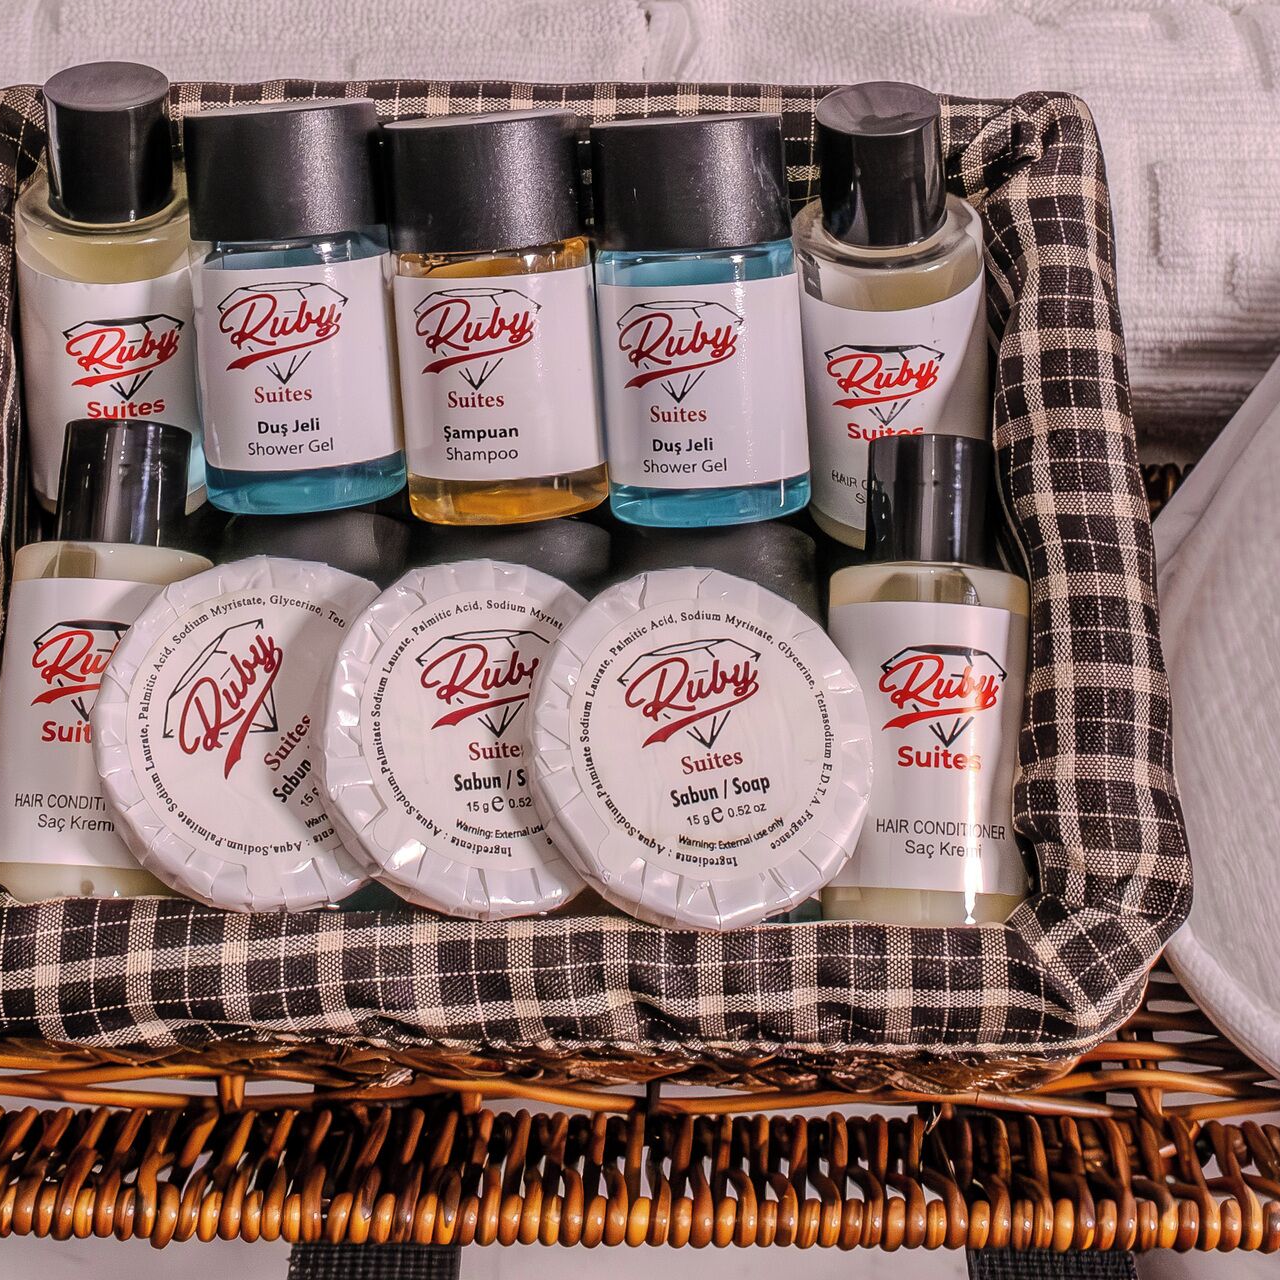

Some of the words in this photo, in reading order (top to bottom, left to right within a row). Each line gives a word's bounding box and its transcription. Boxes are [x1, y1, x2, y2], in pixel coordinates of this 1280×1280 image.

[219, 293, 342, 372] Ruby
[416, 298, 537, 374] Ruby
[65, 327, 183, 388] Ruby
[619, 312, 740, 389] Ruby
[826, 353, 941, 409] Ruby
[254, 385, 313, 404] Suites
[447, 391, 505, 409] Suites
[87, 398, 165, 419] Suites
[650, 405, 707, 423] Suites
[257, 420, 288, 436] Duş
[292, 416, 321, 433] Jeli
[443, 425, 519, 443] Şampuan
[248, 440, 303, 456] Shower
[308, 438, 335, 453] Gel
[446, 446, 519, 463] Shampoo
[652, 438, 682, 457] Duş
[686, 437, 713, 452] Jeli
[643, 459, 697, 474] Shower
[702, 458, 727, 473] Gel
[831, 469, 858, 488] HAIR
[210, 596, 266, 618] Myristate,
[172, 614, 209, 645] Sodium
[156, 646, 176, 672] Acid,
[371, 676, 388, 717] Sodium
[411, 609, 452, 636] Palmitic
[455, 601, 483, 613] Acid,
[486, 599, 526, 613] Sodium
[580, 701, 592, 742] Sodium
[609, 627, 648, 656] Palmitic
[650, 614, 678, 631] Acid,
[680, 610, 721, 622] Sodium
[725, 613, 775, 645] Myristate,
[778, 641, 815, 690] Glycerine,
[815, 690, 835, 759] Tetrasodium
[878, 654, 1000, 731] Ruby
[138, 673, 157, 720] Palmitic
[179, 635, 283, 780] Ruby
[625, 657, 759, 748] Ruby
[681, 751, 744, 775] Suites
[897, 745, 982, 771] Suites
[151, 773, 178, 812] Sodium
[454, 771, 502, 792] Sabun
[670, 785, 719, 808] Sabun
[732, 776, 771, 795] Soap
[14, 793, 44, 808] HAIR
[466, 800, 480, 812] 15
[508, 796, 532, 809] 0.52
[37, 813, 66, 833] Saç
[686, 814, 700, 826] 15
[727, 804, 752, 818] 0.52
[753, 803, 767, 813] oz
[455, 818, 493, 839] Warning:
[494, 826, 530, 839] External
[678, 833, 717, 851] Warning:
[718, 834, 752, 851] External
[753, 828, 768, 840] use
[768, 816, 785, 834] only
[875, 818, 909, 835] HAIR
[904, 839, 935, 859] Saç
